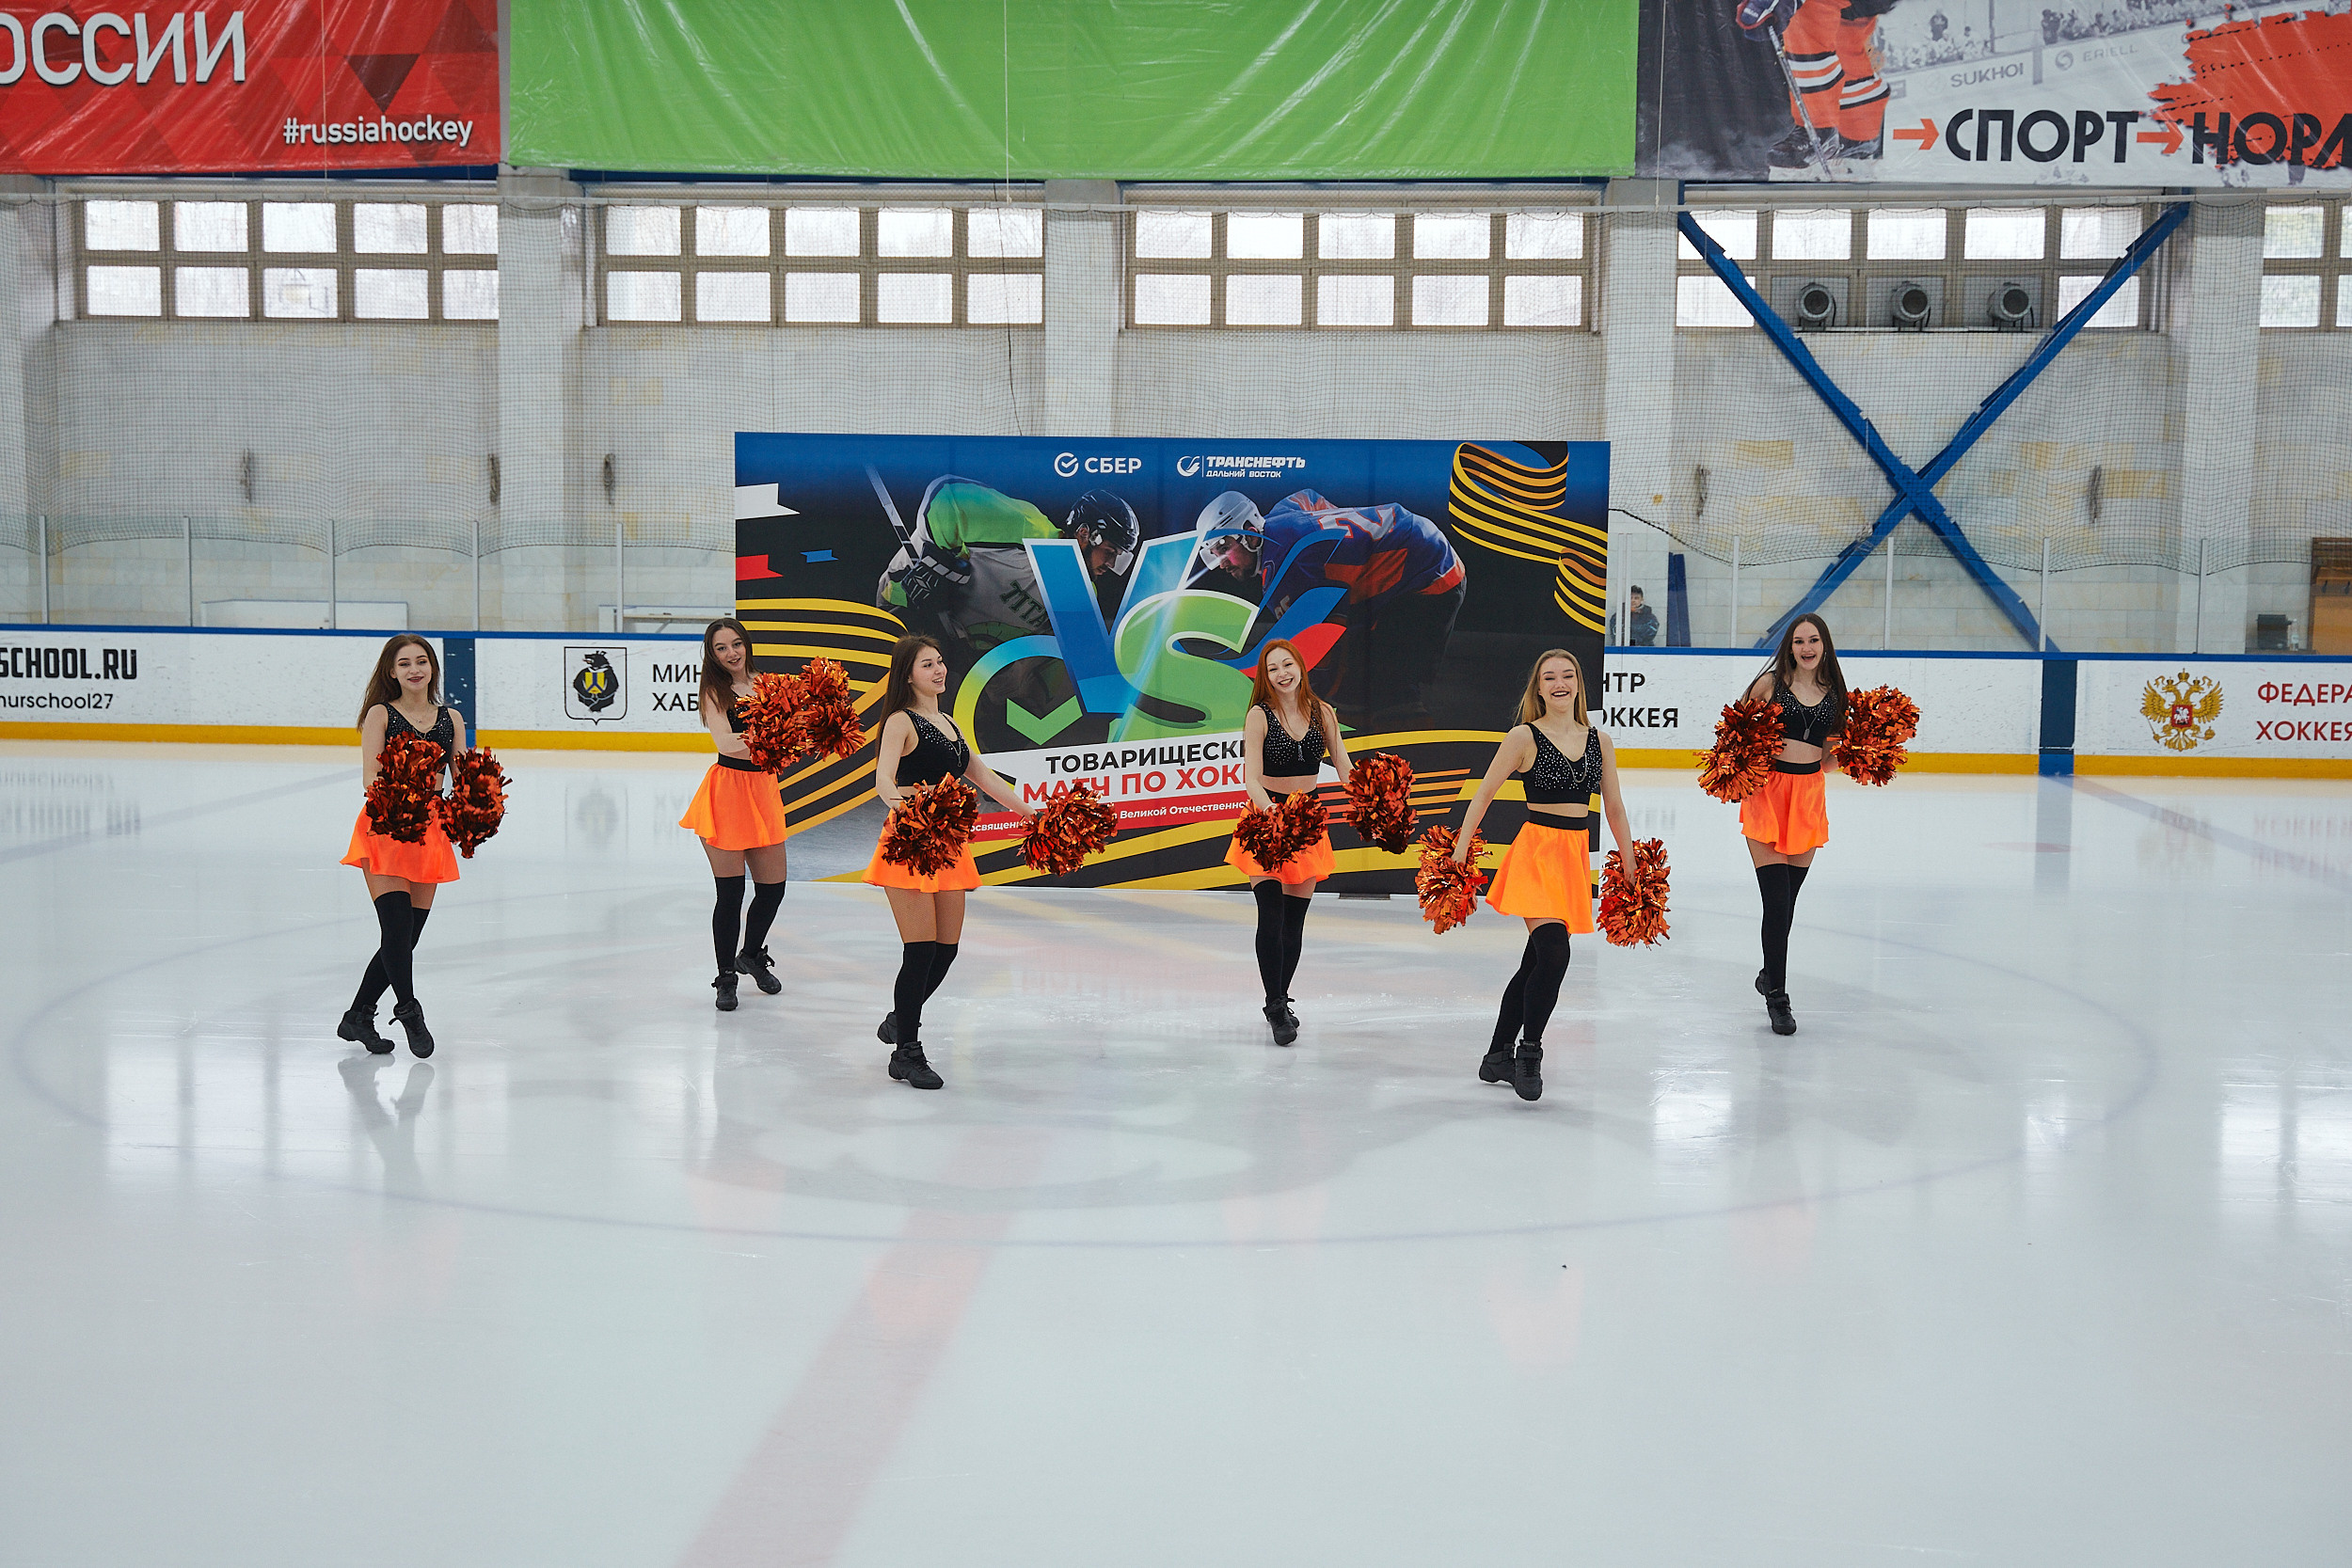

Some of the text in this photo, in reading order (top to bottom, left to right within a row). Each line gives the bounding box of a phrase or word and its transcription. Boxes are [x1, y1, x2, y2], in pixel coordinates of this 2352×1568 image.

[1950, 62, 2024, 88] SUKHOI
[283, 115, 473, 147] #russiahockey
[1946, 108, 2138, 164] СПОРТ
[1084, 457, 1142, 474] СБЕР
[1206, 456, 1306, 468] ТРАНСНЕФТЬ
[1206, 468, 1246, 478] ДАЛЬНИЙ
[0, 647, 137, 680] SCHOOL.RU
[1602, 707, 1678, 728] ККЕЯ
[1121, 771, 1167, 796] ПО
[1176, 763, 1246, 790] ХОК
[1120, 806, 1167, 819] Великой
